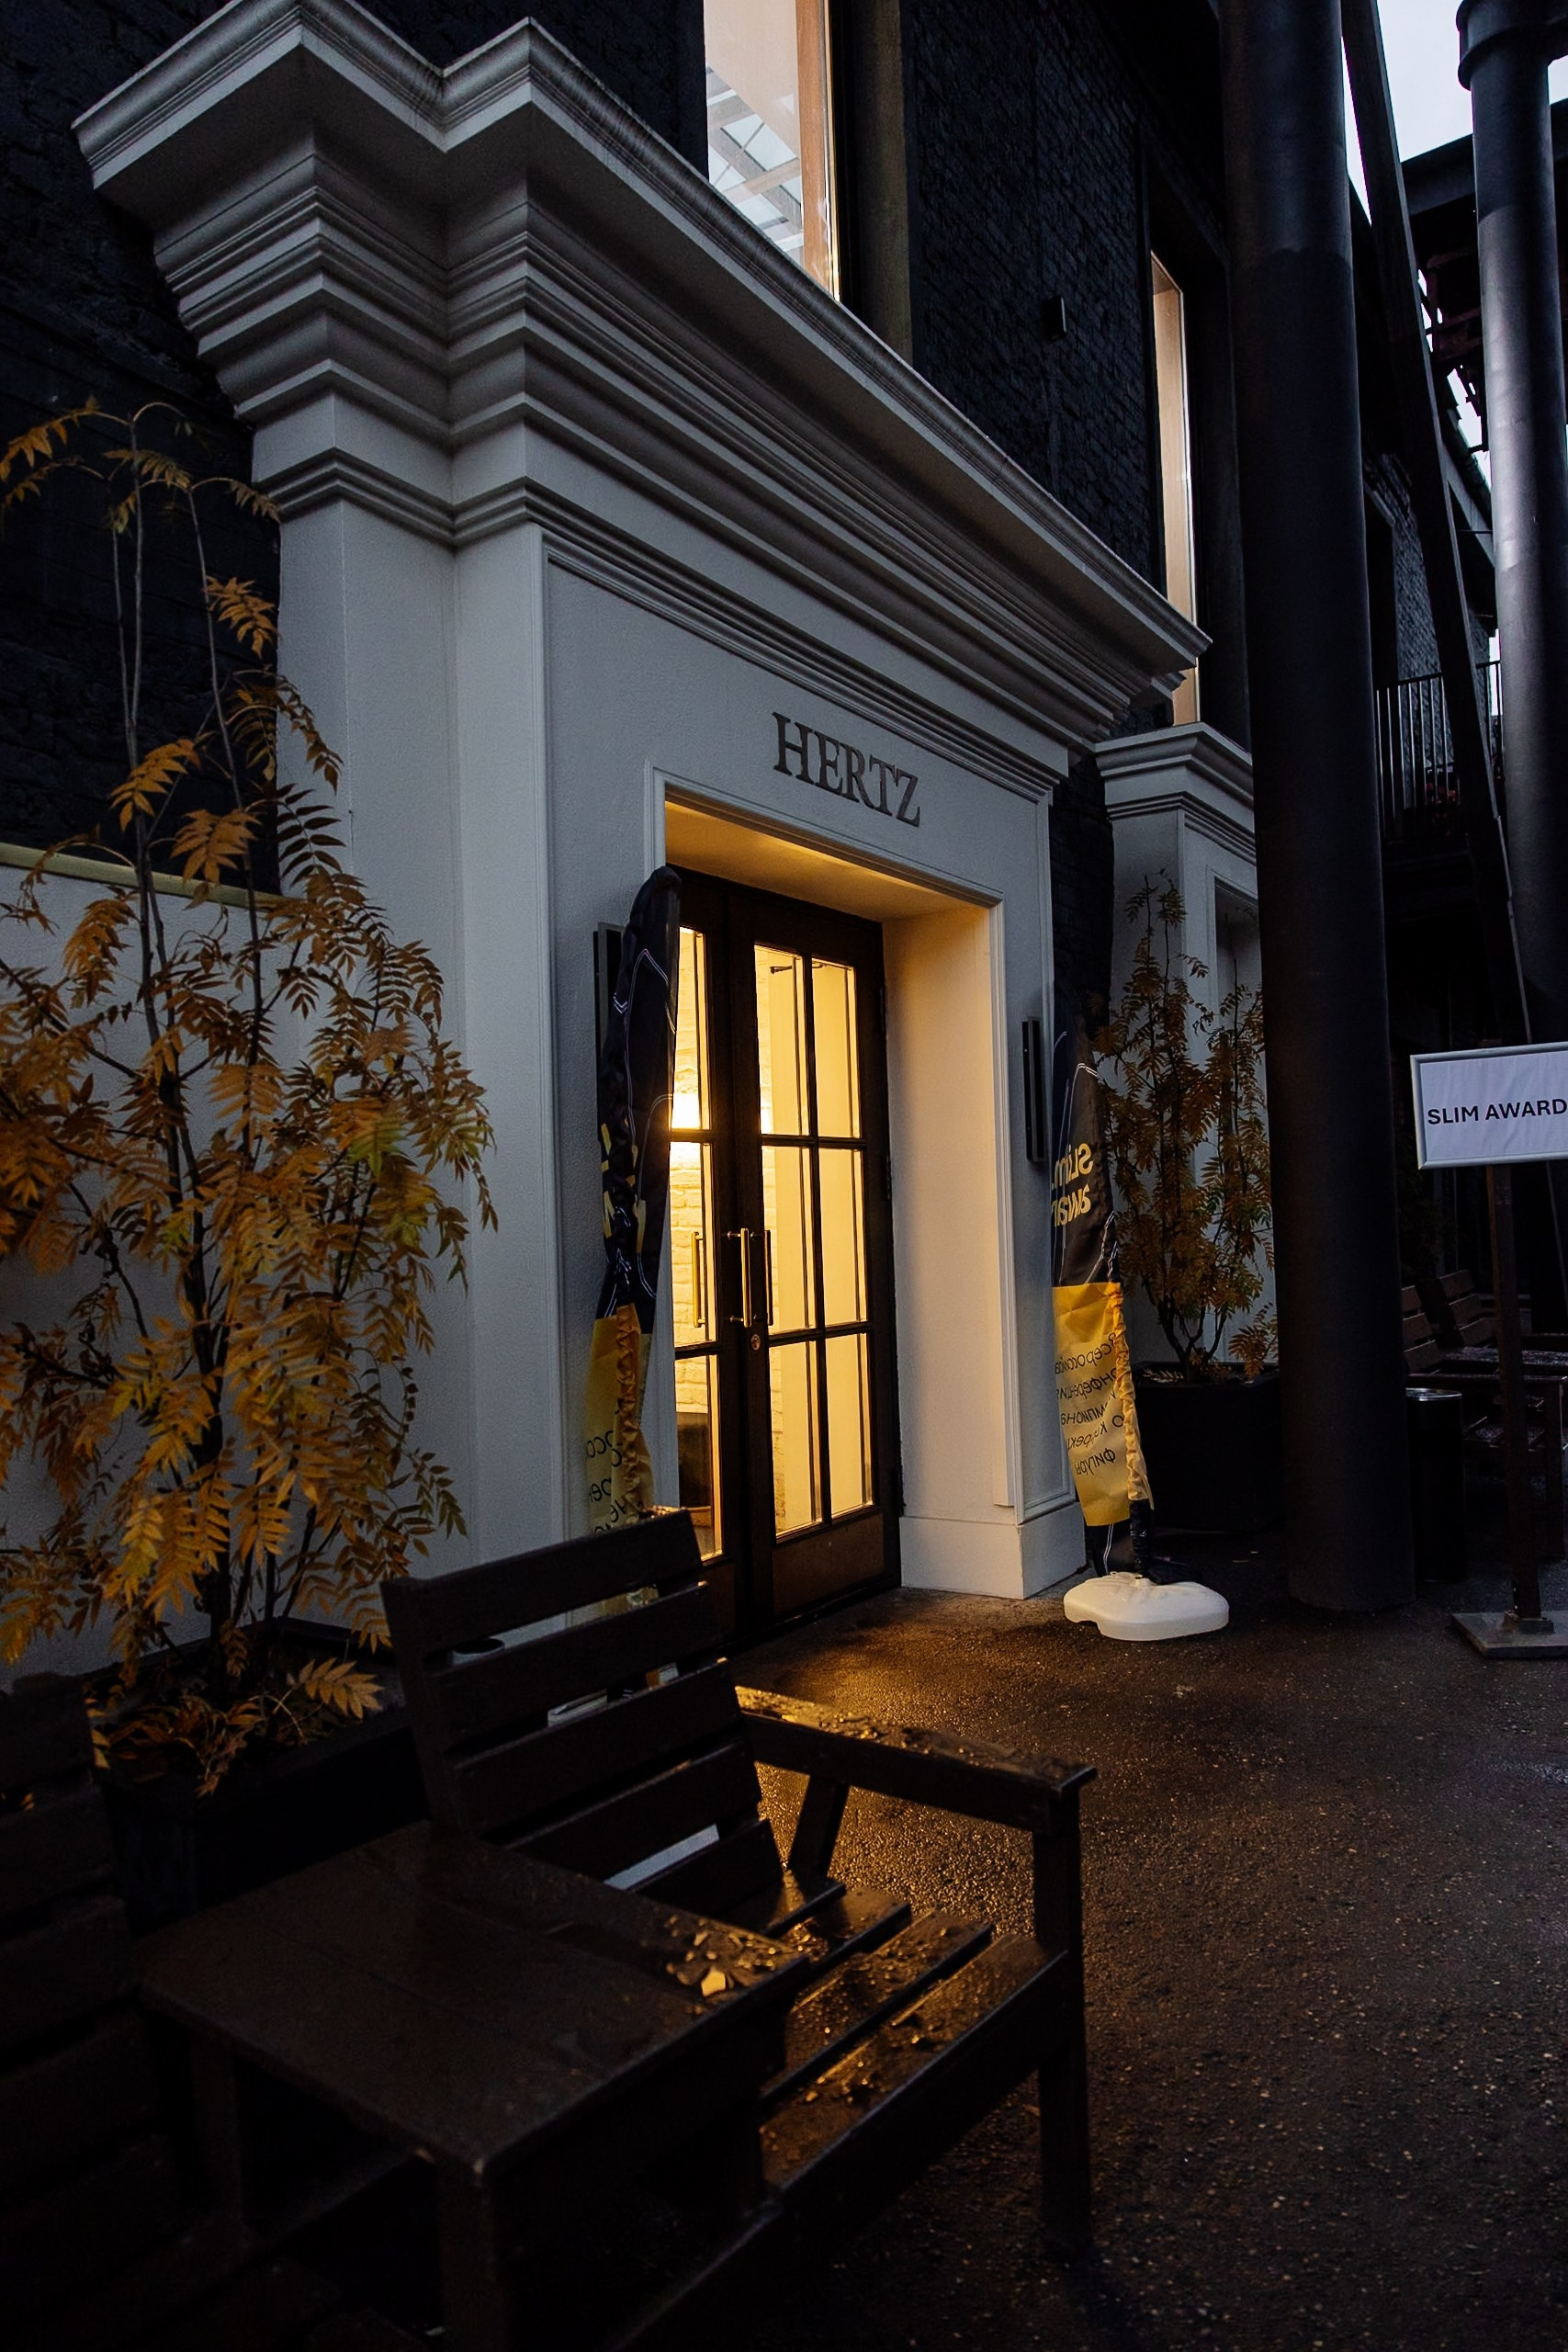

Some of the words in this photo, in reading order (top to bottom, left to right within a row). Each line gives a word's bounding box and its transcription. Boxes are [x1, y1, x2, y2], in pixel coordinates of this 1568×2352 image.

[772, 711, 920, 828] HERTZ
[1427, 1105, 1479, 1125] SLIM
[1484, 1098, 1567, 1121] AWARD
